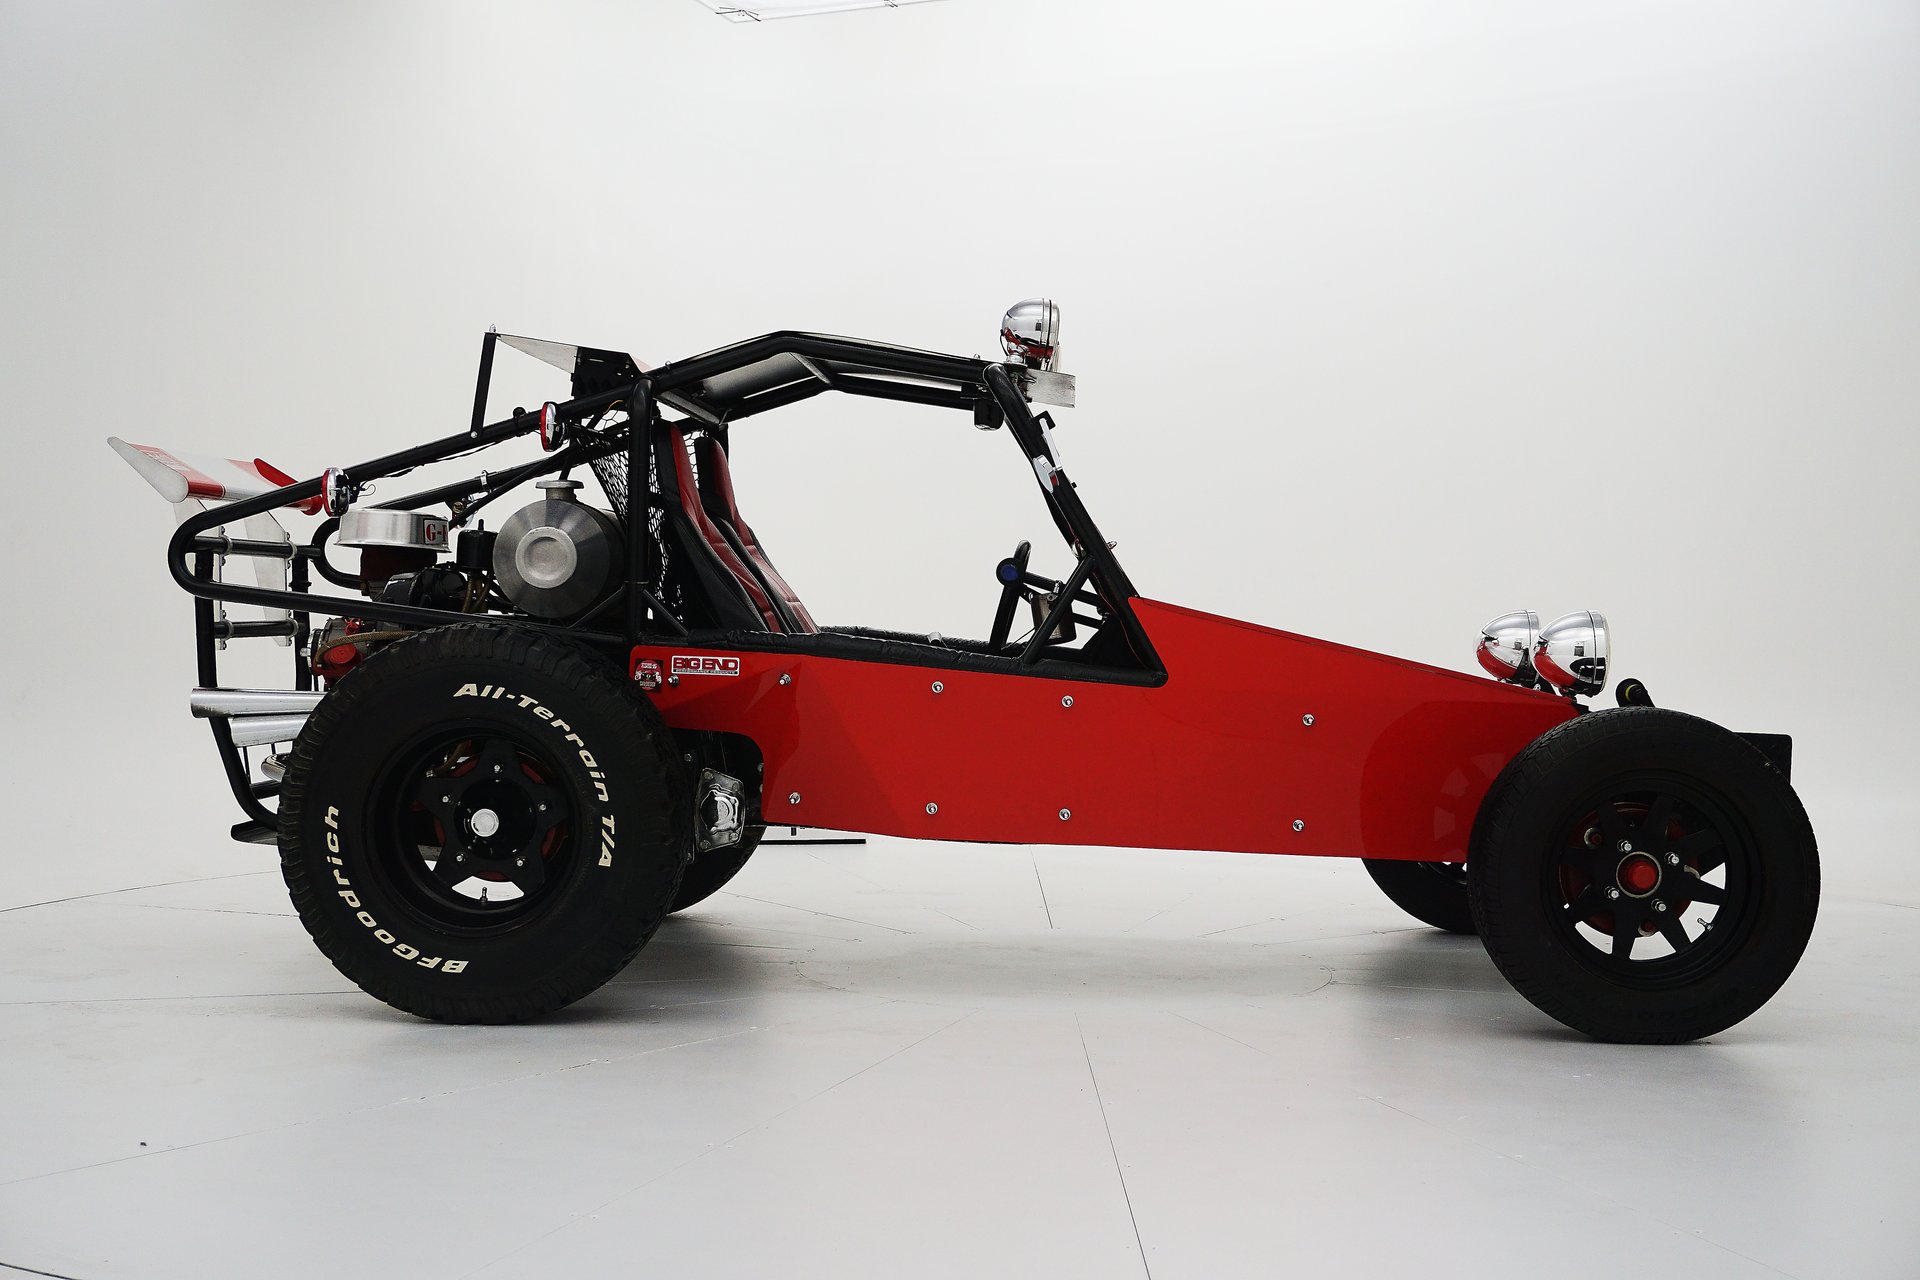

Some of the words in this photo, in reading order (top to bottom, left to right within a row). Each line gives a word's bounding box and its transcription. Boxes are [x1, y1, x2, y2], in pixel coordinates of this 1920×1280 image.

[673, 657, 700, 669] BIG
[702, 658, 738, 670] END
[453, 683, 610, 802] All-Terrain
[598, 814, 616, 868] T/A
[324, 805, 470, 974] BFGoodrich
